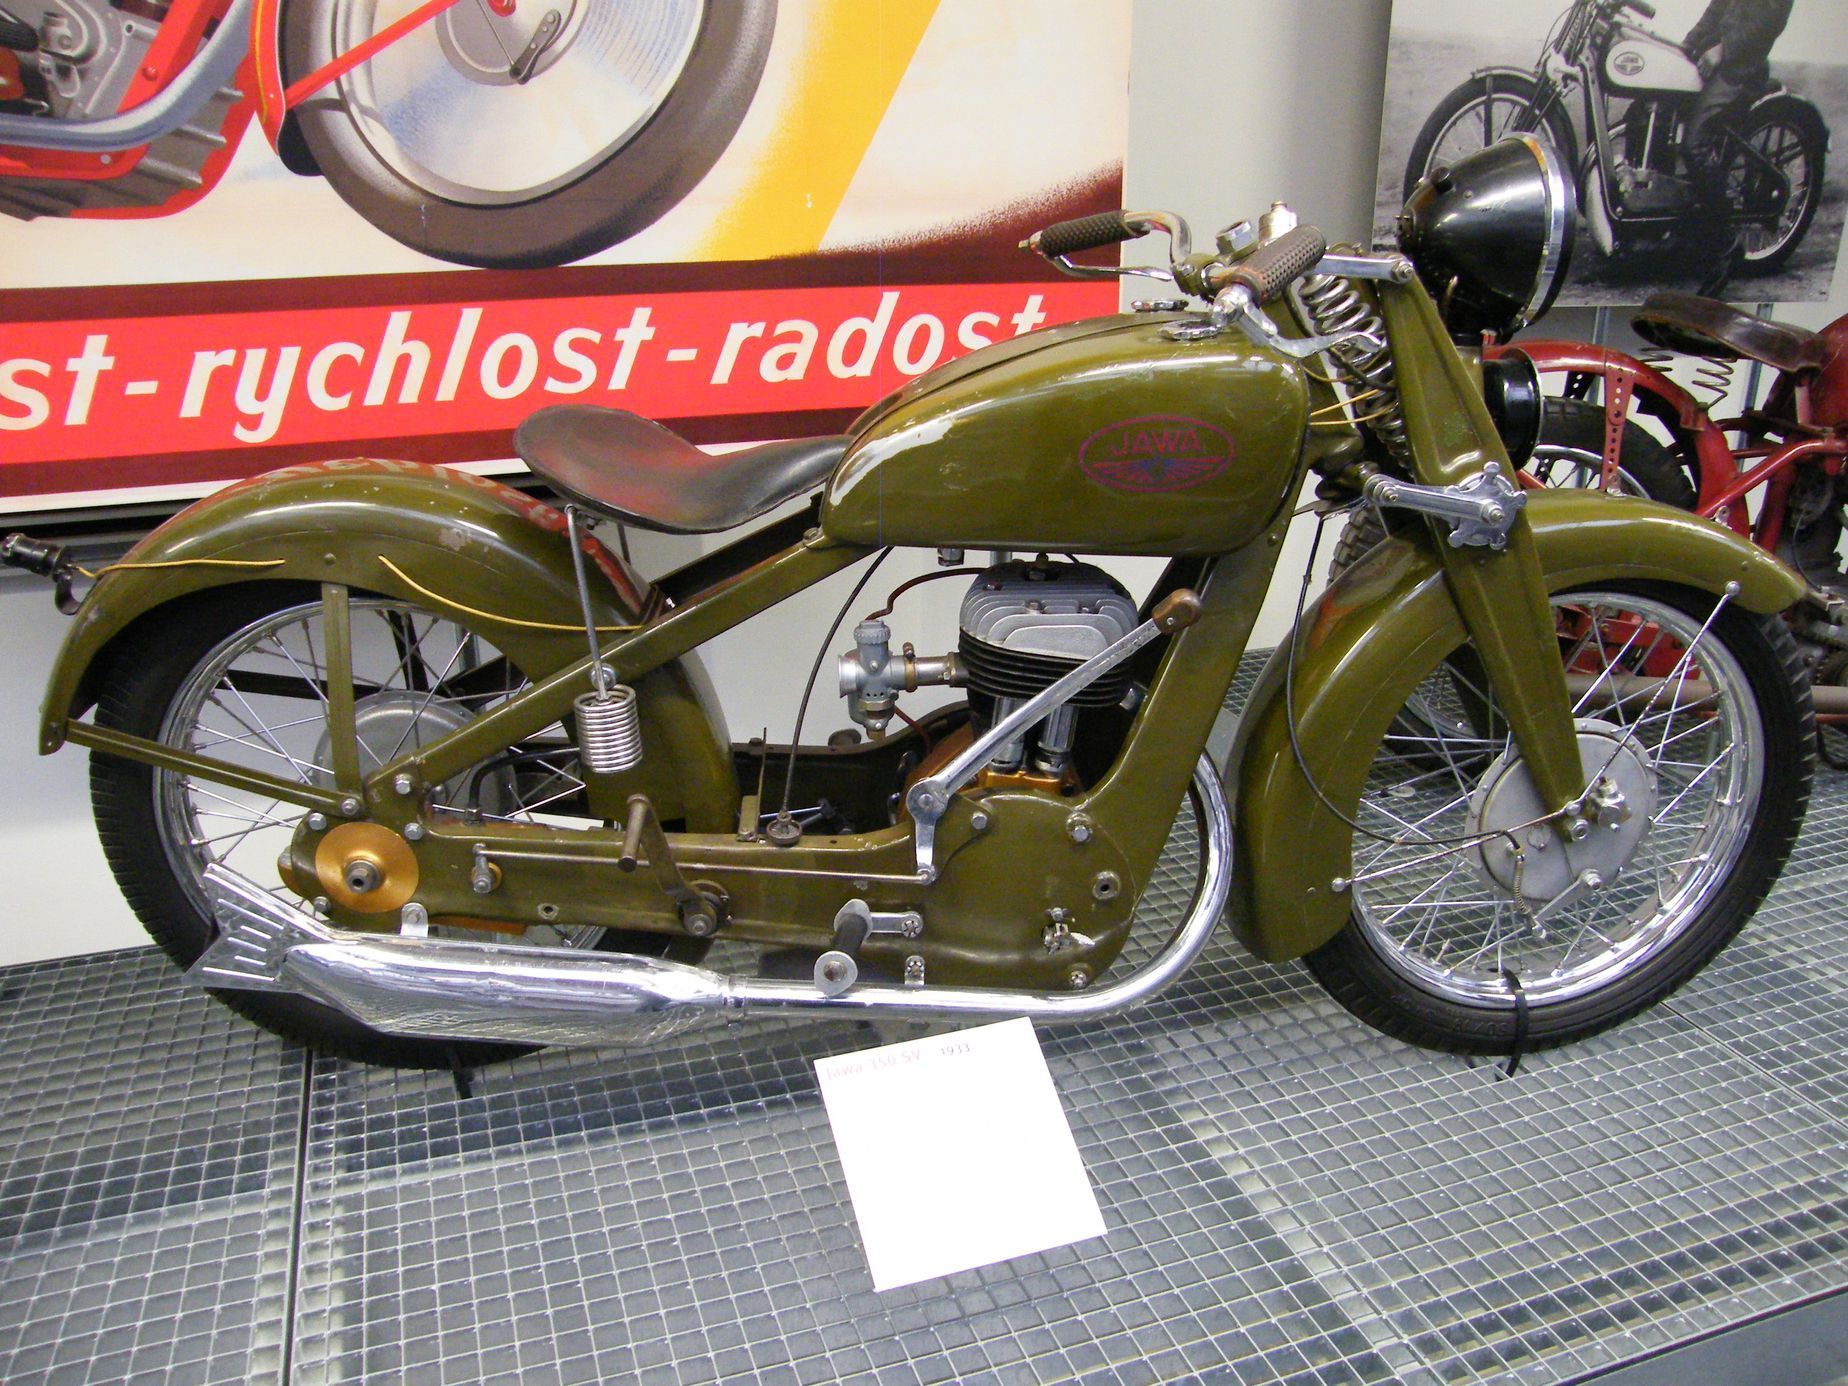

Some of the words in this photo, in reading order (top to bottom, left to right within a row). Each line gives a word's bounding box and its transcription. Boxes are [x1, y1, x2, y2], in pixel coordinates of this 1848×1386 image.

[1109, 428, 1203, 457] JAWA
[825, 1063, 864, 1081] Jawa
[871, 1054, 897, 1070] 350
[901, 1047, 921, 1064] SV
[940, 1042, 971, 1057] 1933
